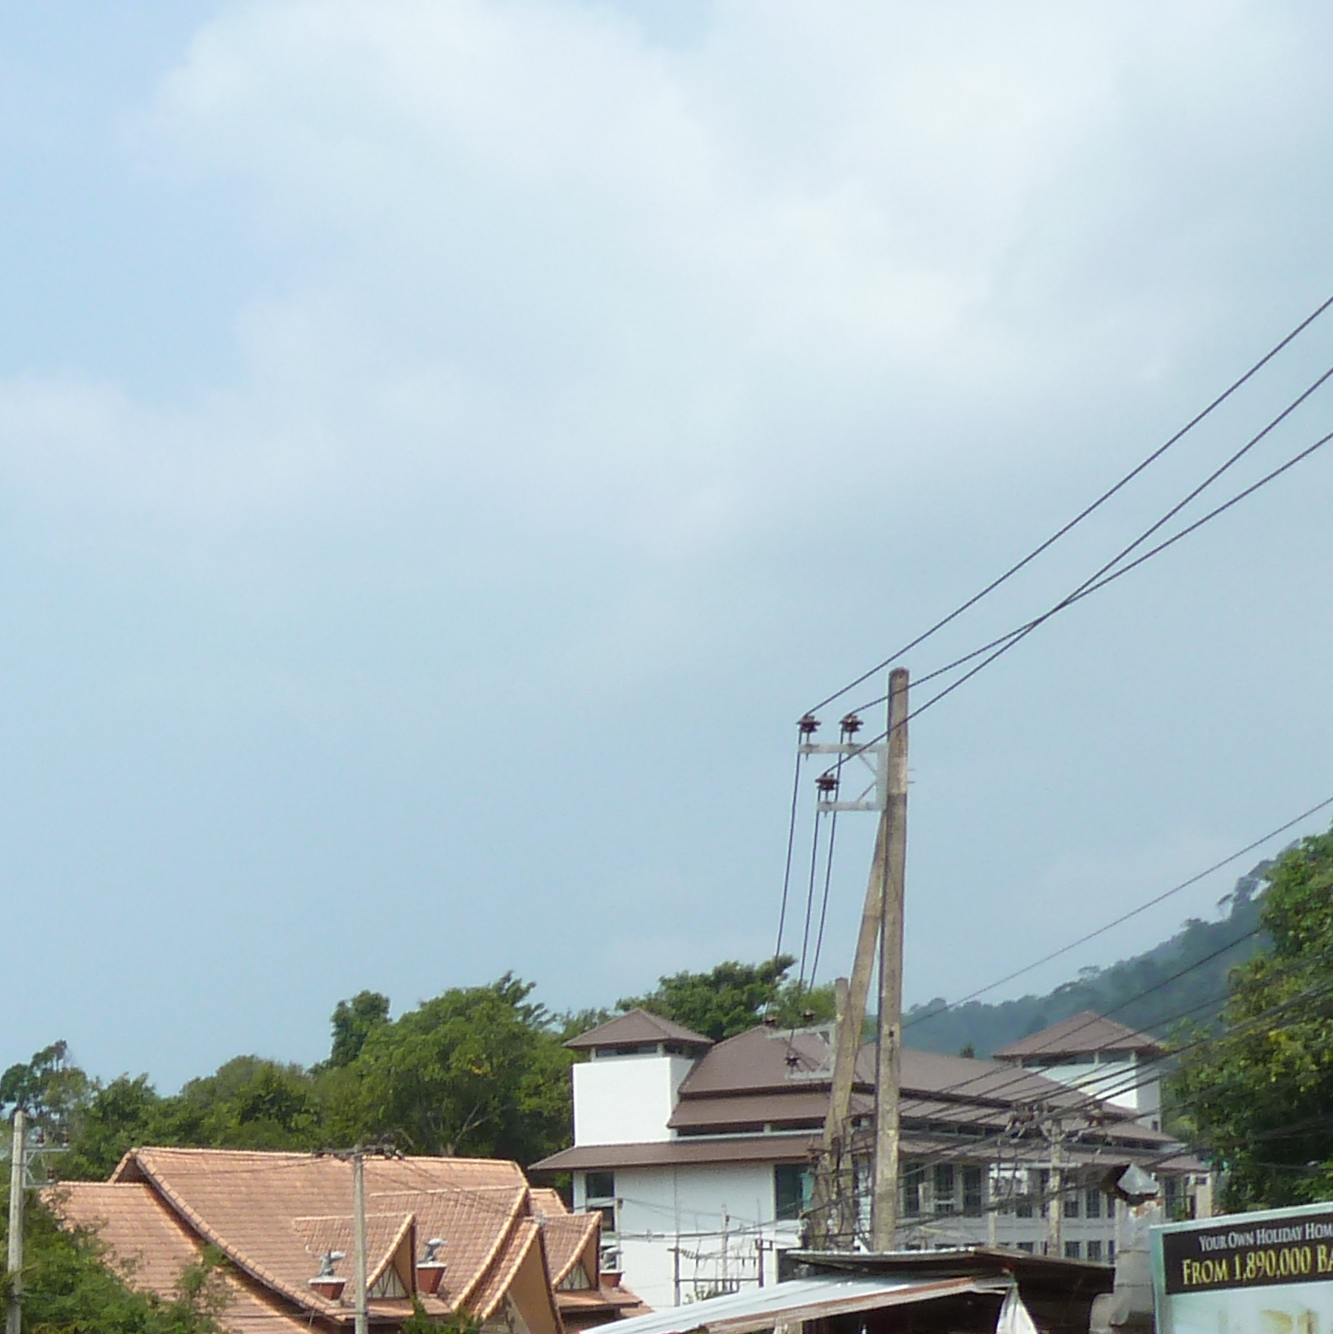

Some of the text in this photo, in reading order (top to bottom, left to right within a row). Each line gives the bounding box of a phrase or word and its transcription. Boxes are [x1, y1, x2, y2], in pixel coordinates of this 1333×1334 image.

[1199, 1235, 1228, 1251] YOUR
[1228, 1231, 1255, 1248] OWN
[1256, 1226, 1303, 1245] HOLIDAY
[1182, 1258, 1229, 1285] FROM
[1234, 1246, 1312, 1283] 1,890,000
